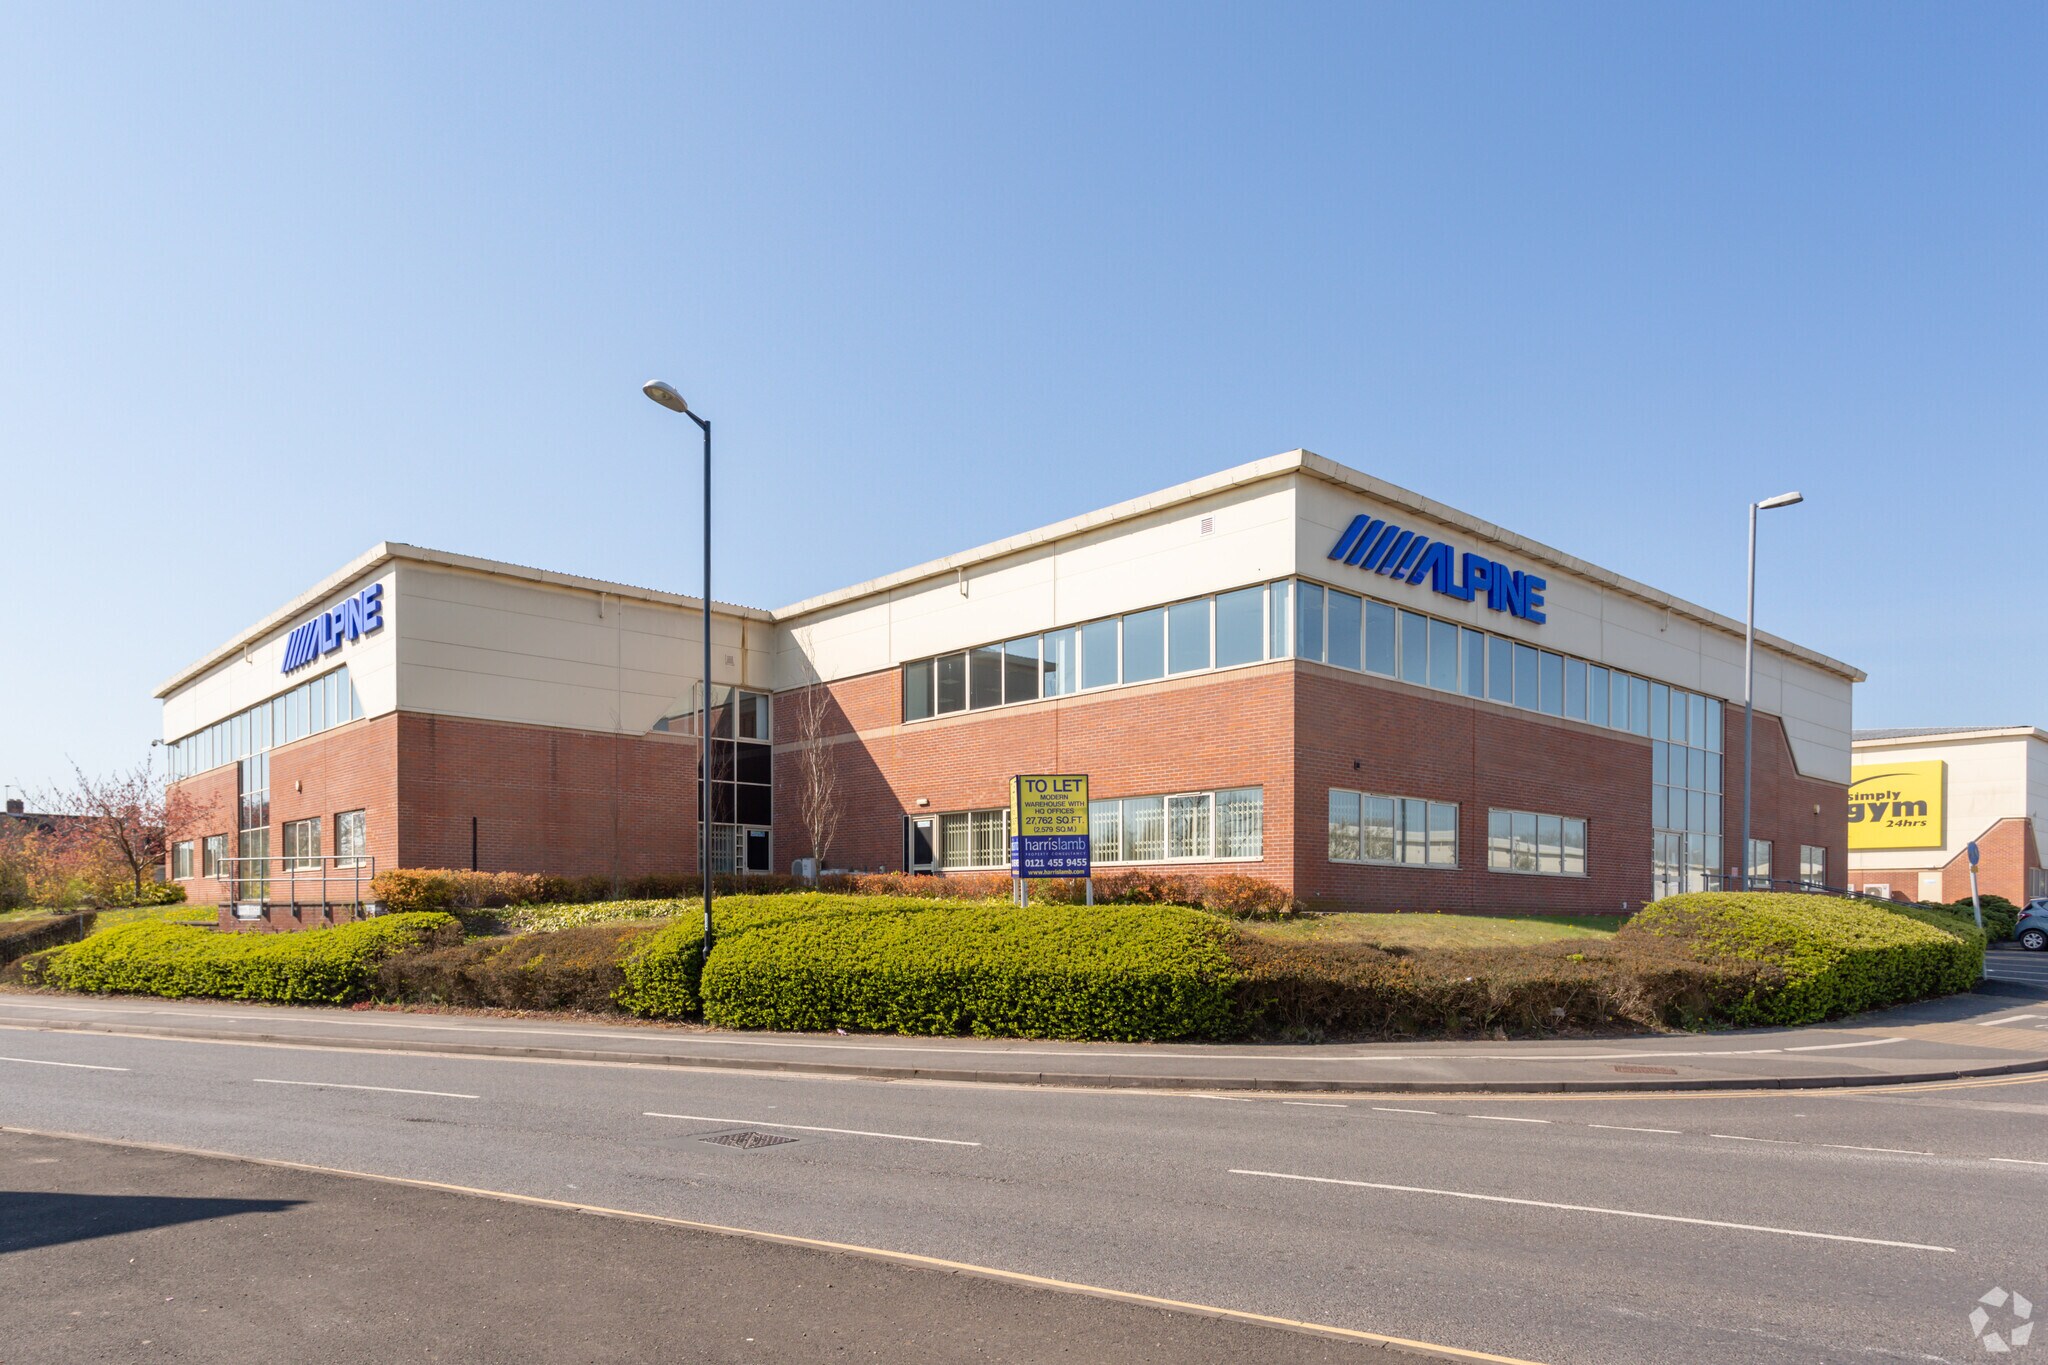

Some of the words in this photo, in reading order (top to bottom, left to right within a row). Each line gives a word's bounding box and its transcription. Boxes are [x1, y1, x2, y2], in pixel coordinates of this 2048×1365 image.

[1025, 779, 1047, 793] TO
[1053, 779, 1082, 792] LET
[1848, 790, 1901, 800] simply
[1848, 800, 1928, 823] gym
[1025, 837, 1086, 851] harrislamb
[1066, 858, 1088, 866] 9455
